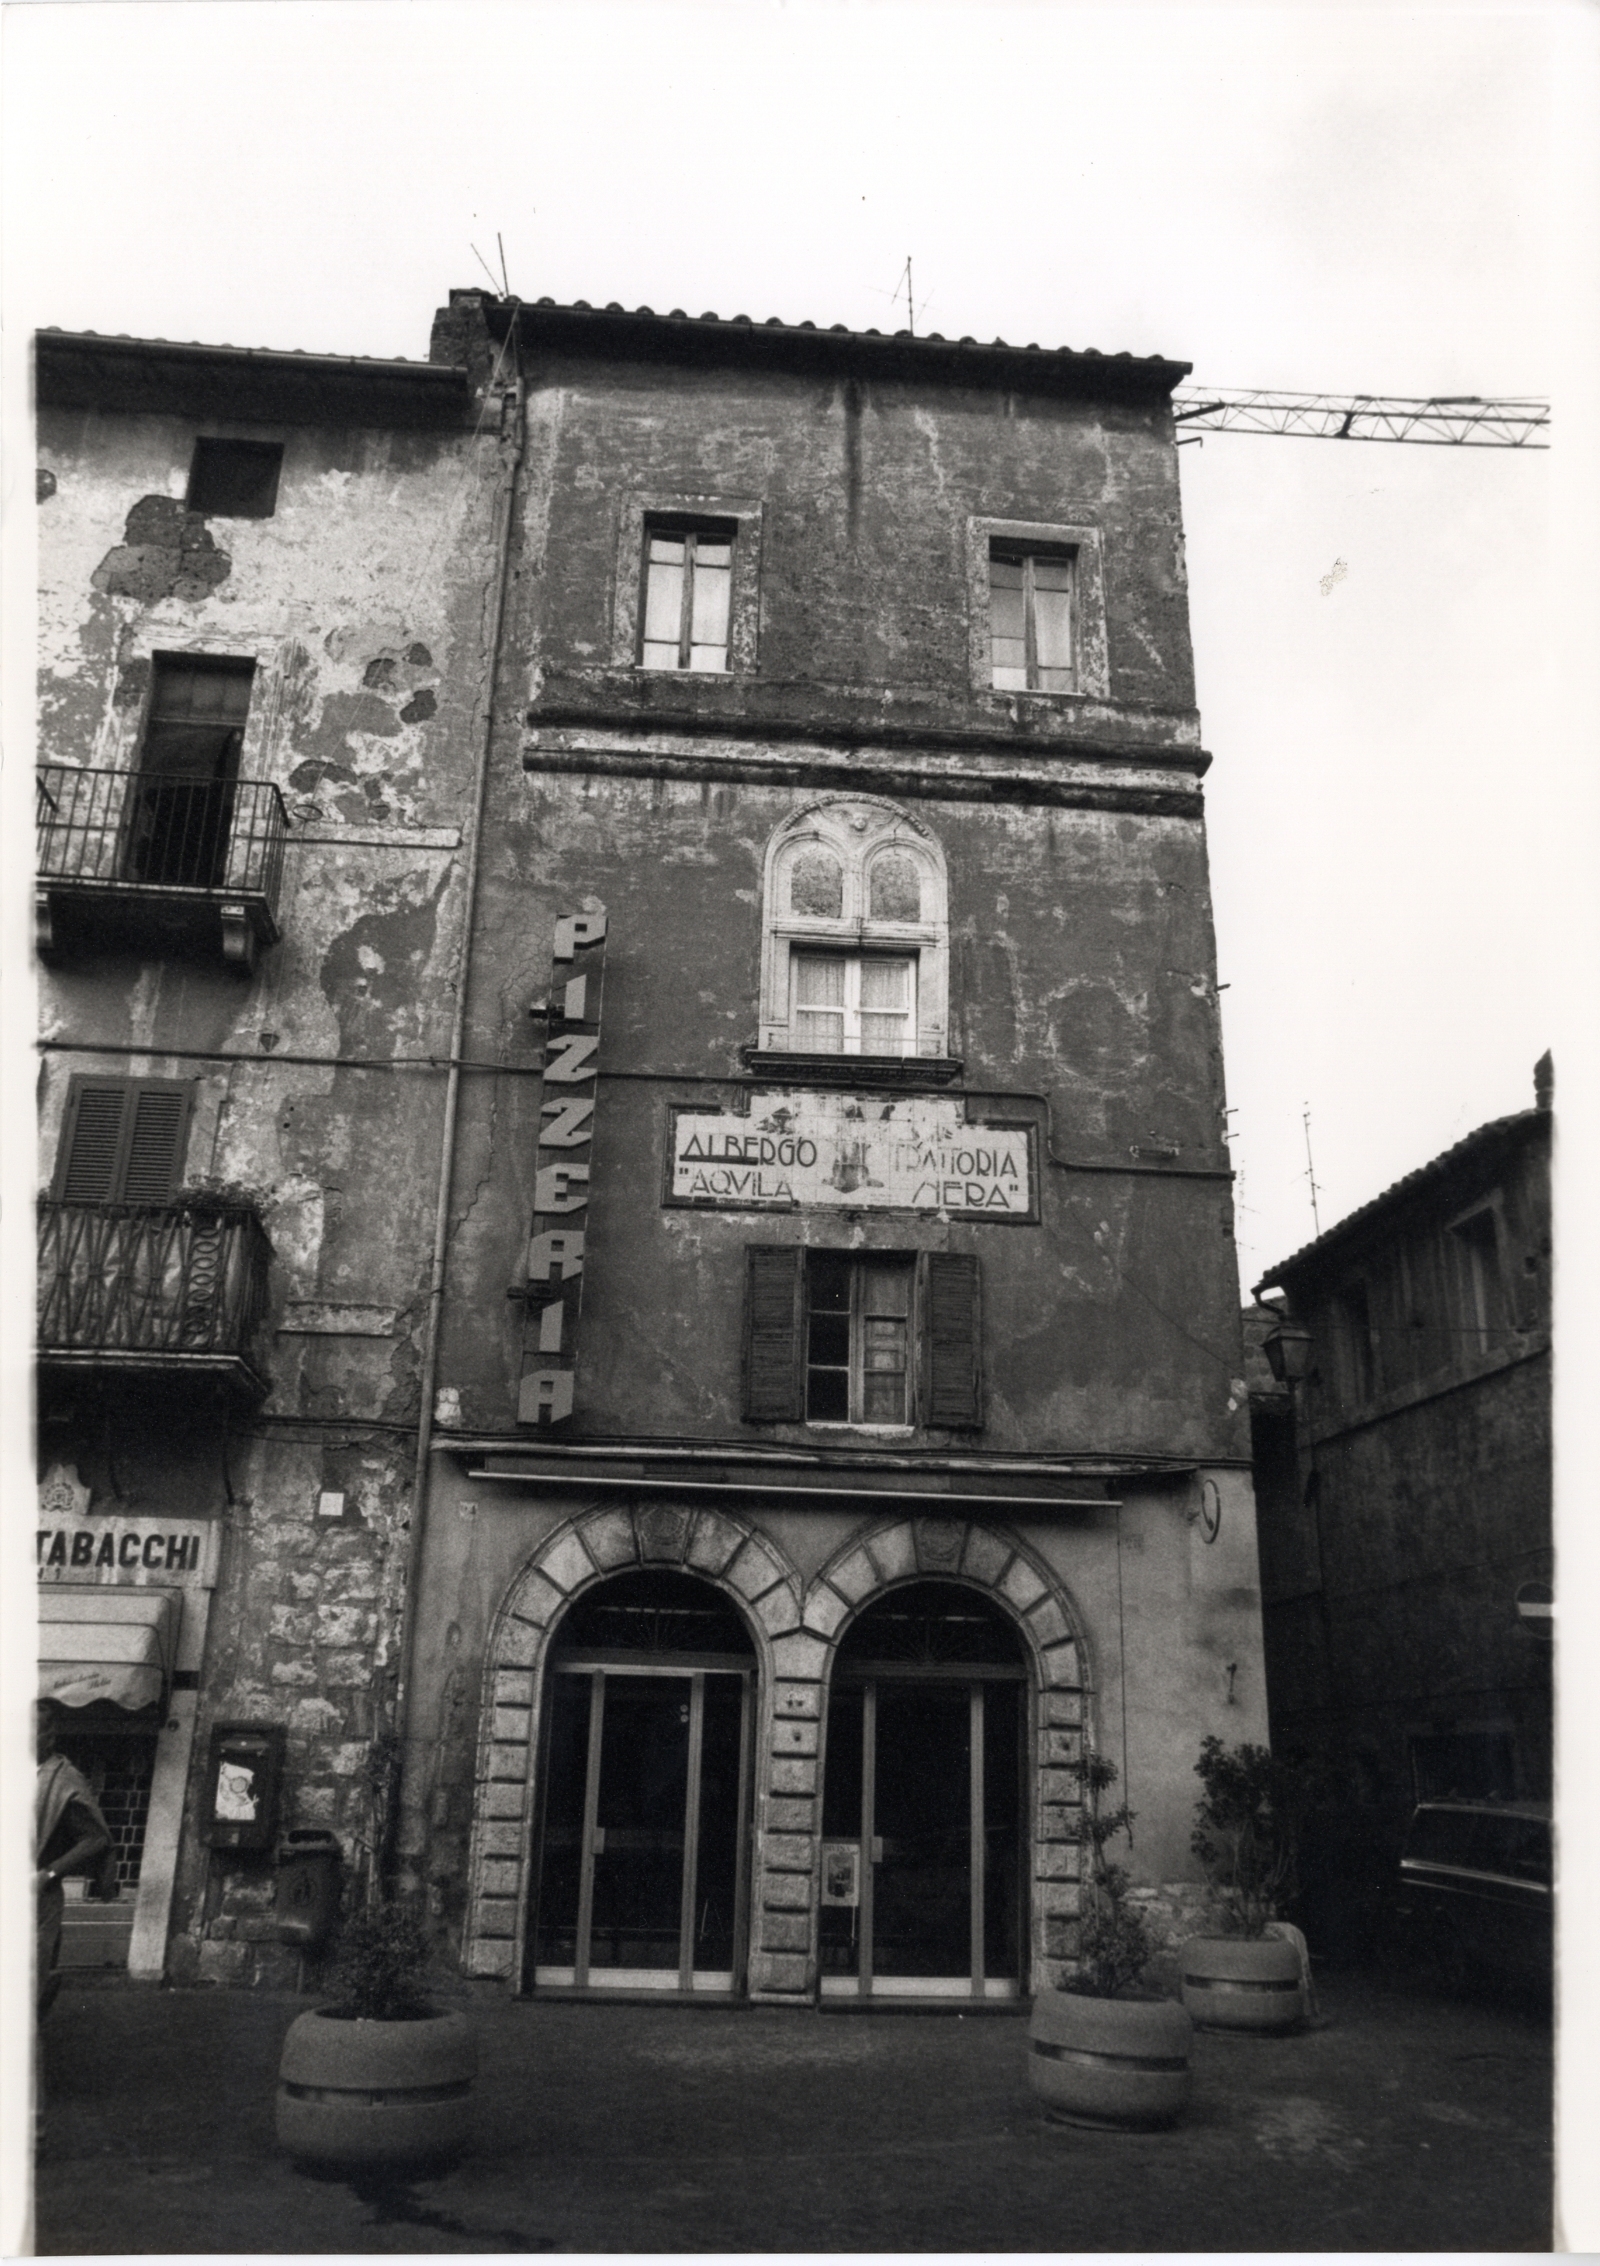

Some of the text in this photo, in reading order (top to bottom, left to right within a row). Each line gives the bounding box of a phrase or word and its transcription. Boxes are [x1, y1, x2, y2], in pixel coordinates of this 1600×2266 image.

[516, 914, 607, 1424] PIZZERIA
[680, 1133, 817, 1168] ALBERGO
[37, 1530, 200, 1571] TABACCHI
